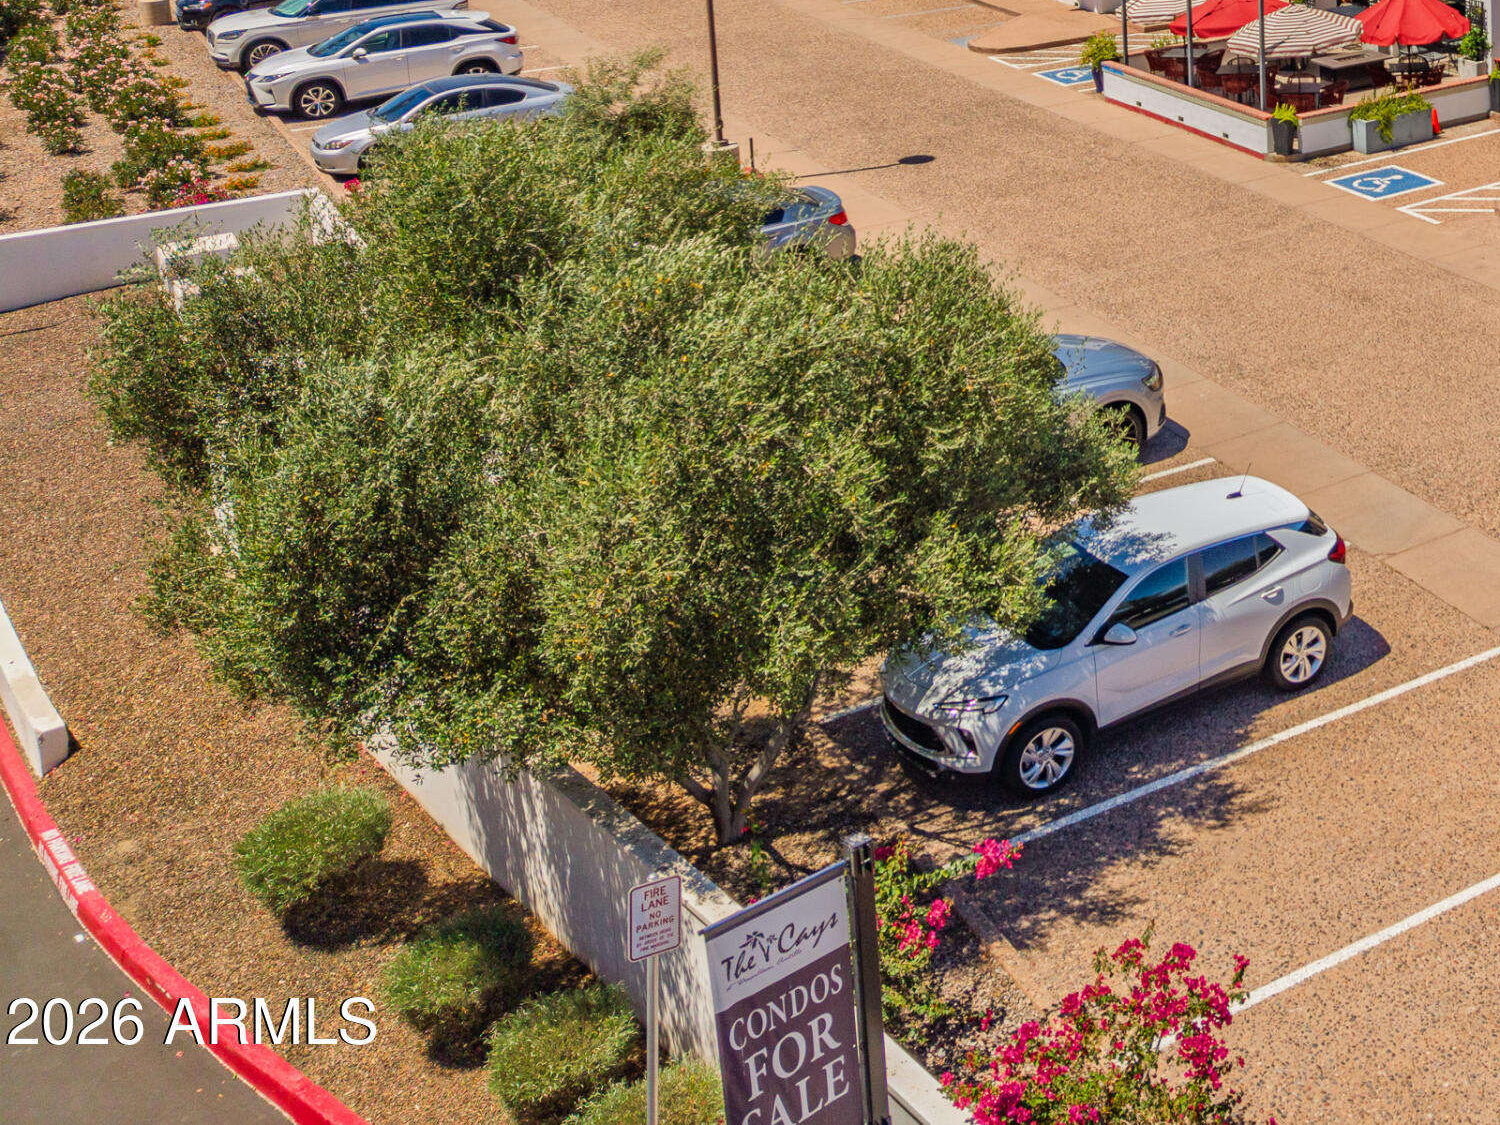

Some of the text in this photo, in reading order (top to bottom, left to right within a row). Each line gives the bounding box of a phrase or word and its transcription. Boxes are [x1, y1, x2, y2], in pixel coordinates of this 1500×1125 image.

[644, 885, 666, 901] FIRE
[641, 895, 670, 913] LANE
[636, 915, 674, 933] PARKING
[649, 910, 661, 920] NO
[721, 949, 756, 982] The
[778, 912, 838, 953] Cays
[729, 963, 843, 1051] CONDOS
[744, 1012, 842, 1102] FOR
